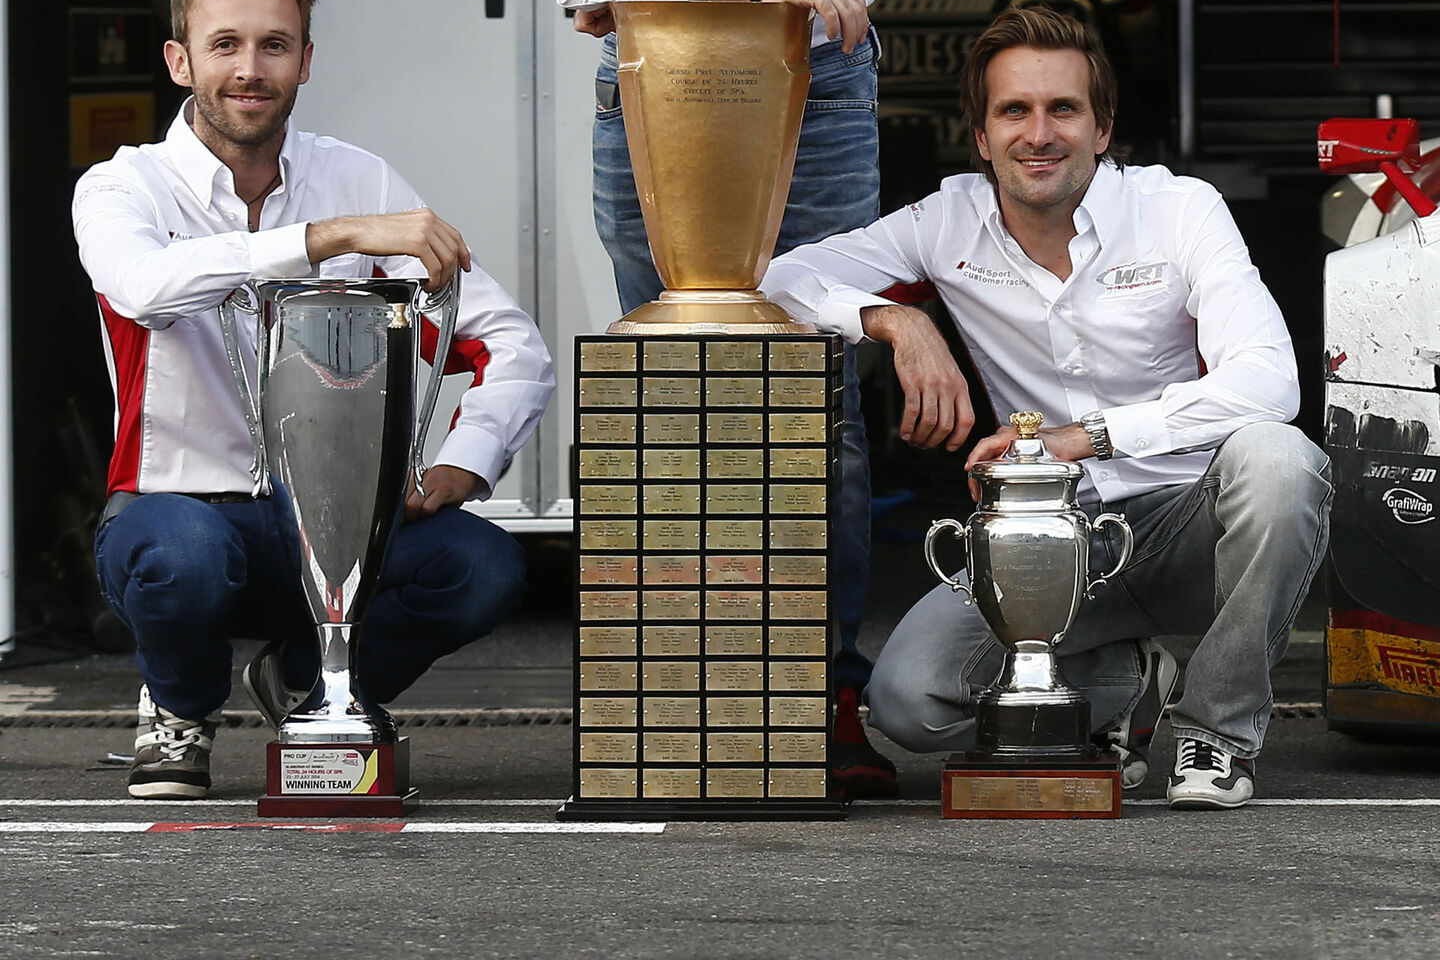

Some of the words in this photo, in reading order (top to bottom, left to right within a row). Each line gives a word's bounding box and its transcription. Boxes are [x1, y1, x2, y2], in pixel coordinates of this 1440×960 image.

[963, 271, 1005, 285] customer
[966, 262, 986, 275] Audi
[985, 269, 1011, 279] Sport
[1114, 261, 1169, 285] WRT
[1386, 495, 1433, 515] GrafiWrap
[285, 780, 326, 789] WINNING
[327, 780, 352, 789] TEAM
